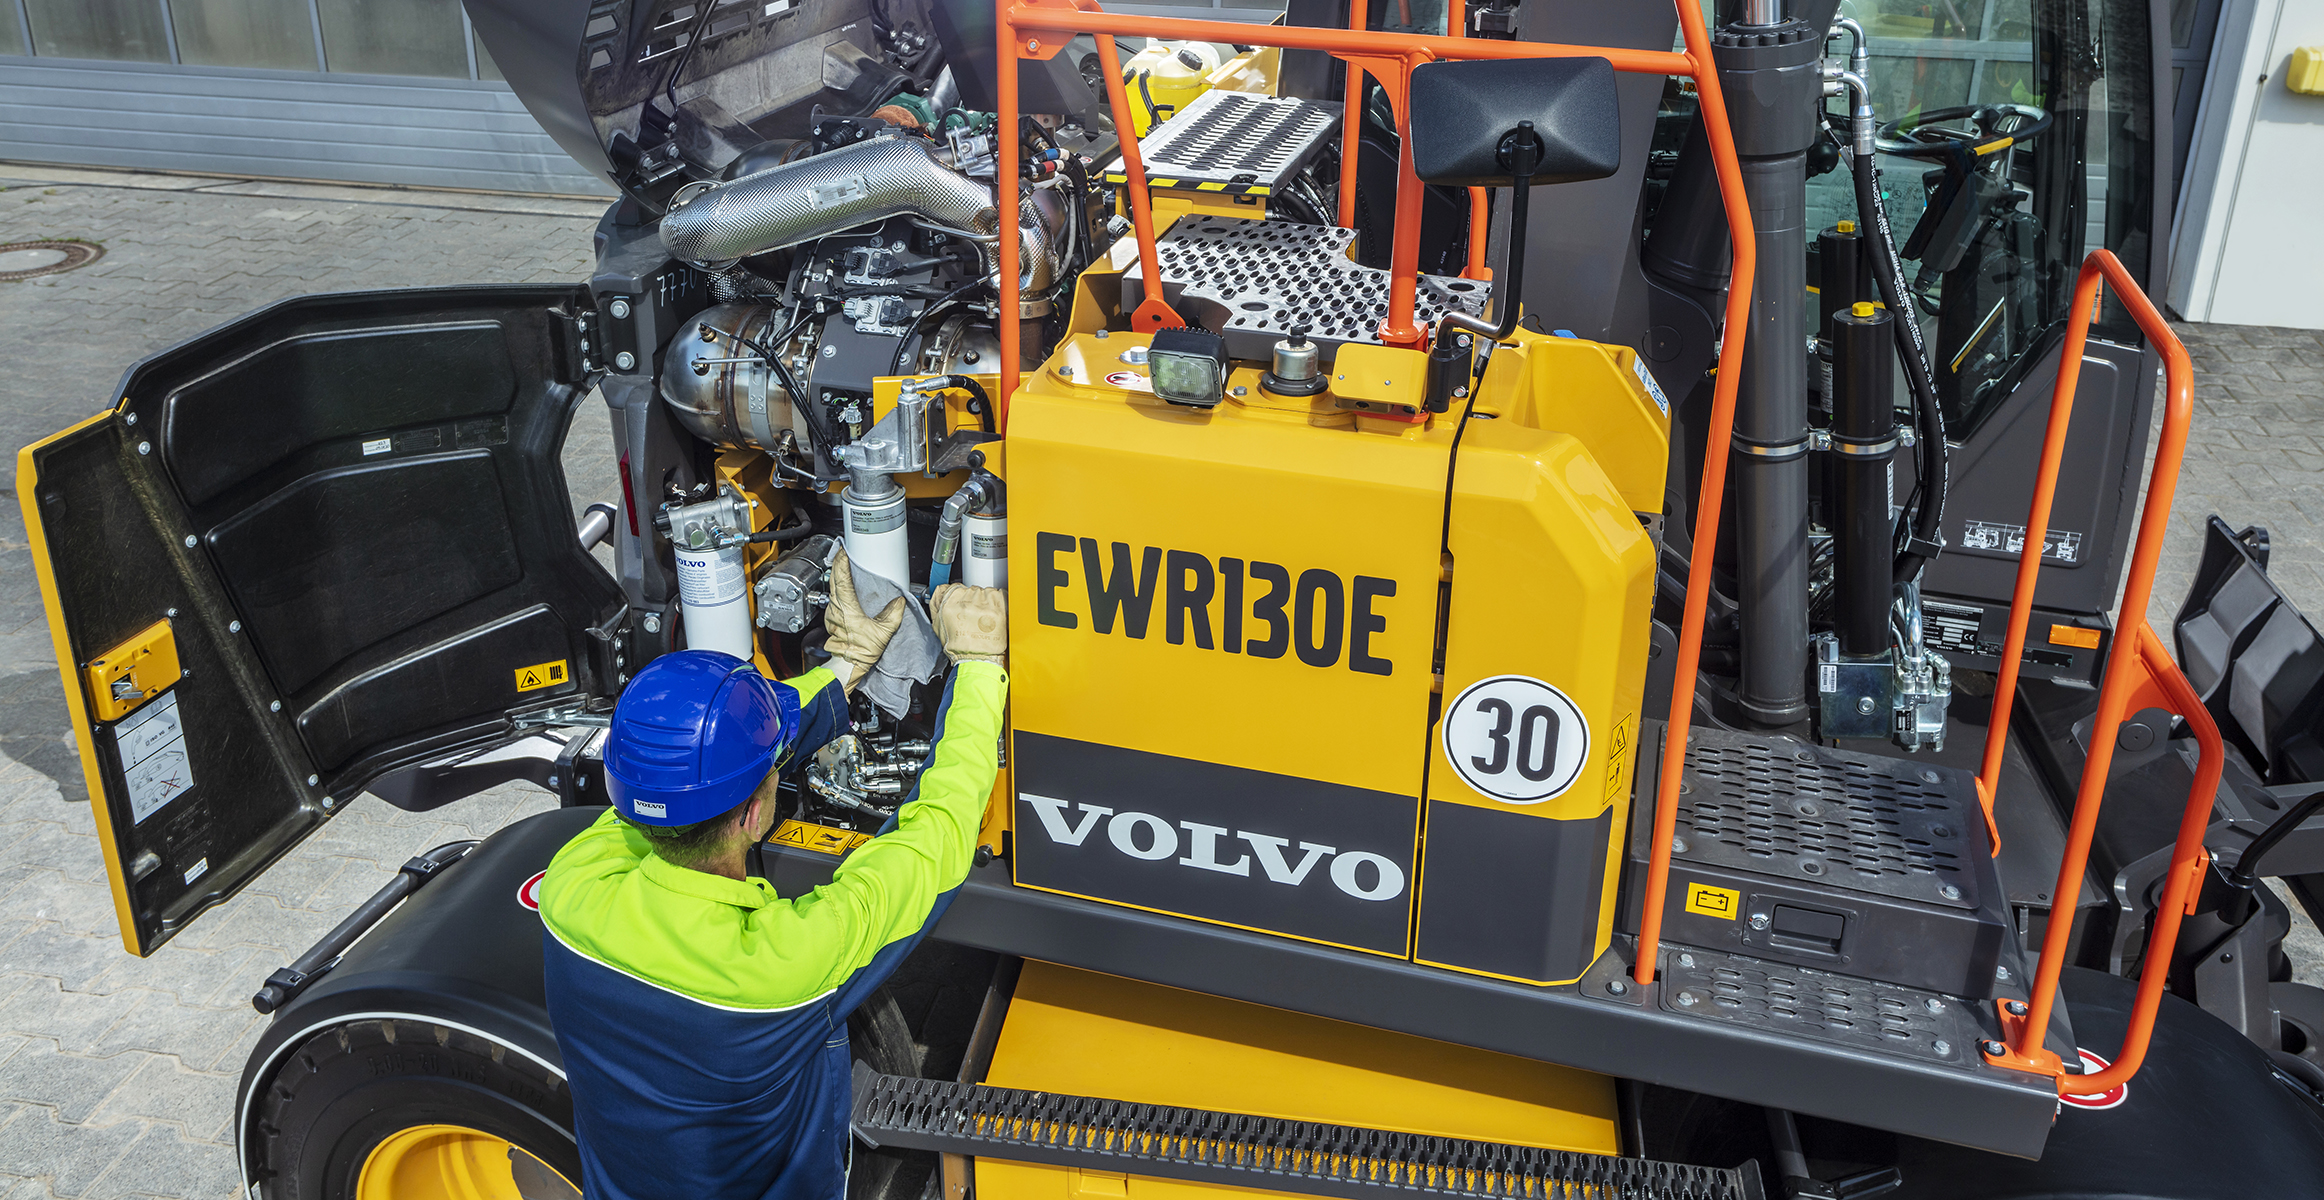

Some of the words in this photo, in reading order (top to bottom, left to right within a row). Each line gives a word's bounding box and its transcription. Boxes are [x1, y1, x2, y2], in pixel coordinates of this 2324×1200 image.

[1036, 530, 1397, 677] EWR130E
[1471, 697, 1560, 782] 30
[635, 800, 666, 810] VOLVO
[1019, 792, 1405, 901] VOLVO
